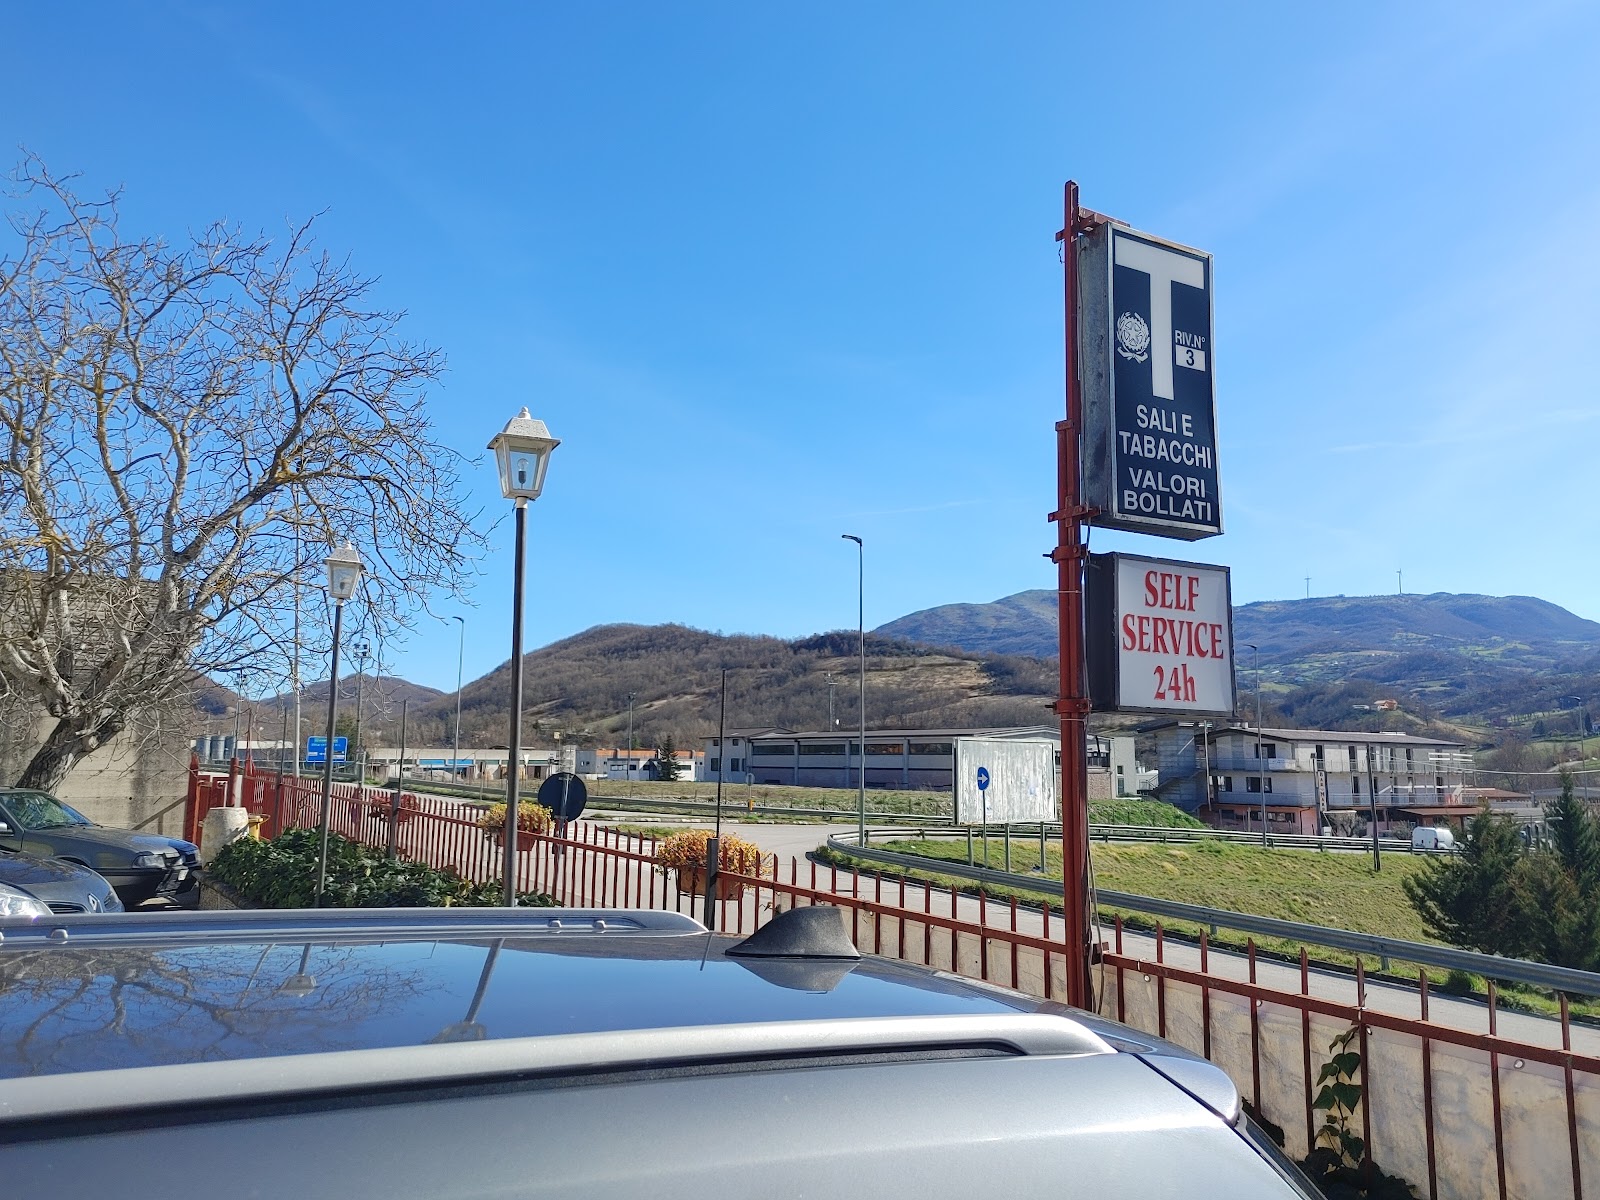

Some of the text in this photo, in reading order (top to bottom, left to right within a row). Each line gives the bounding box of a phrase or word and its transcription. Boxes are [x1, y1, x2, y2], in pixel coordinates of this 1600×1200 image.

[1186, 349, 1195, 366] 3
[1136, 404, 1194, 437] SALI E
[1118, 430, 1212, 469] TABACCHI
[1128, 467, 1206, 498] VALORI
[1123, 489, 1212, 521] BOLLATI
[1144, 570, 1200, 612] SELF
[1122, 613, 1224, 660] SERVICE
[1153, 663, 1197, 702] 24h
